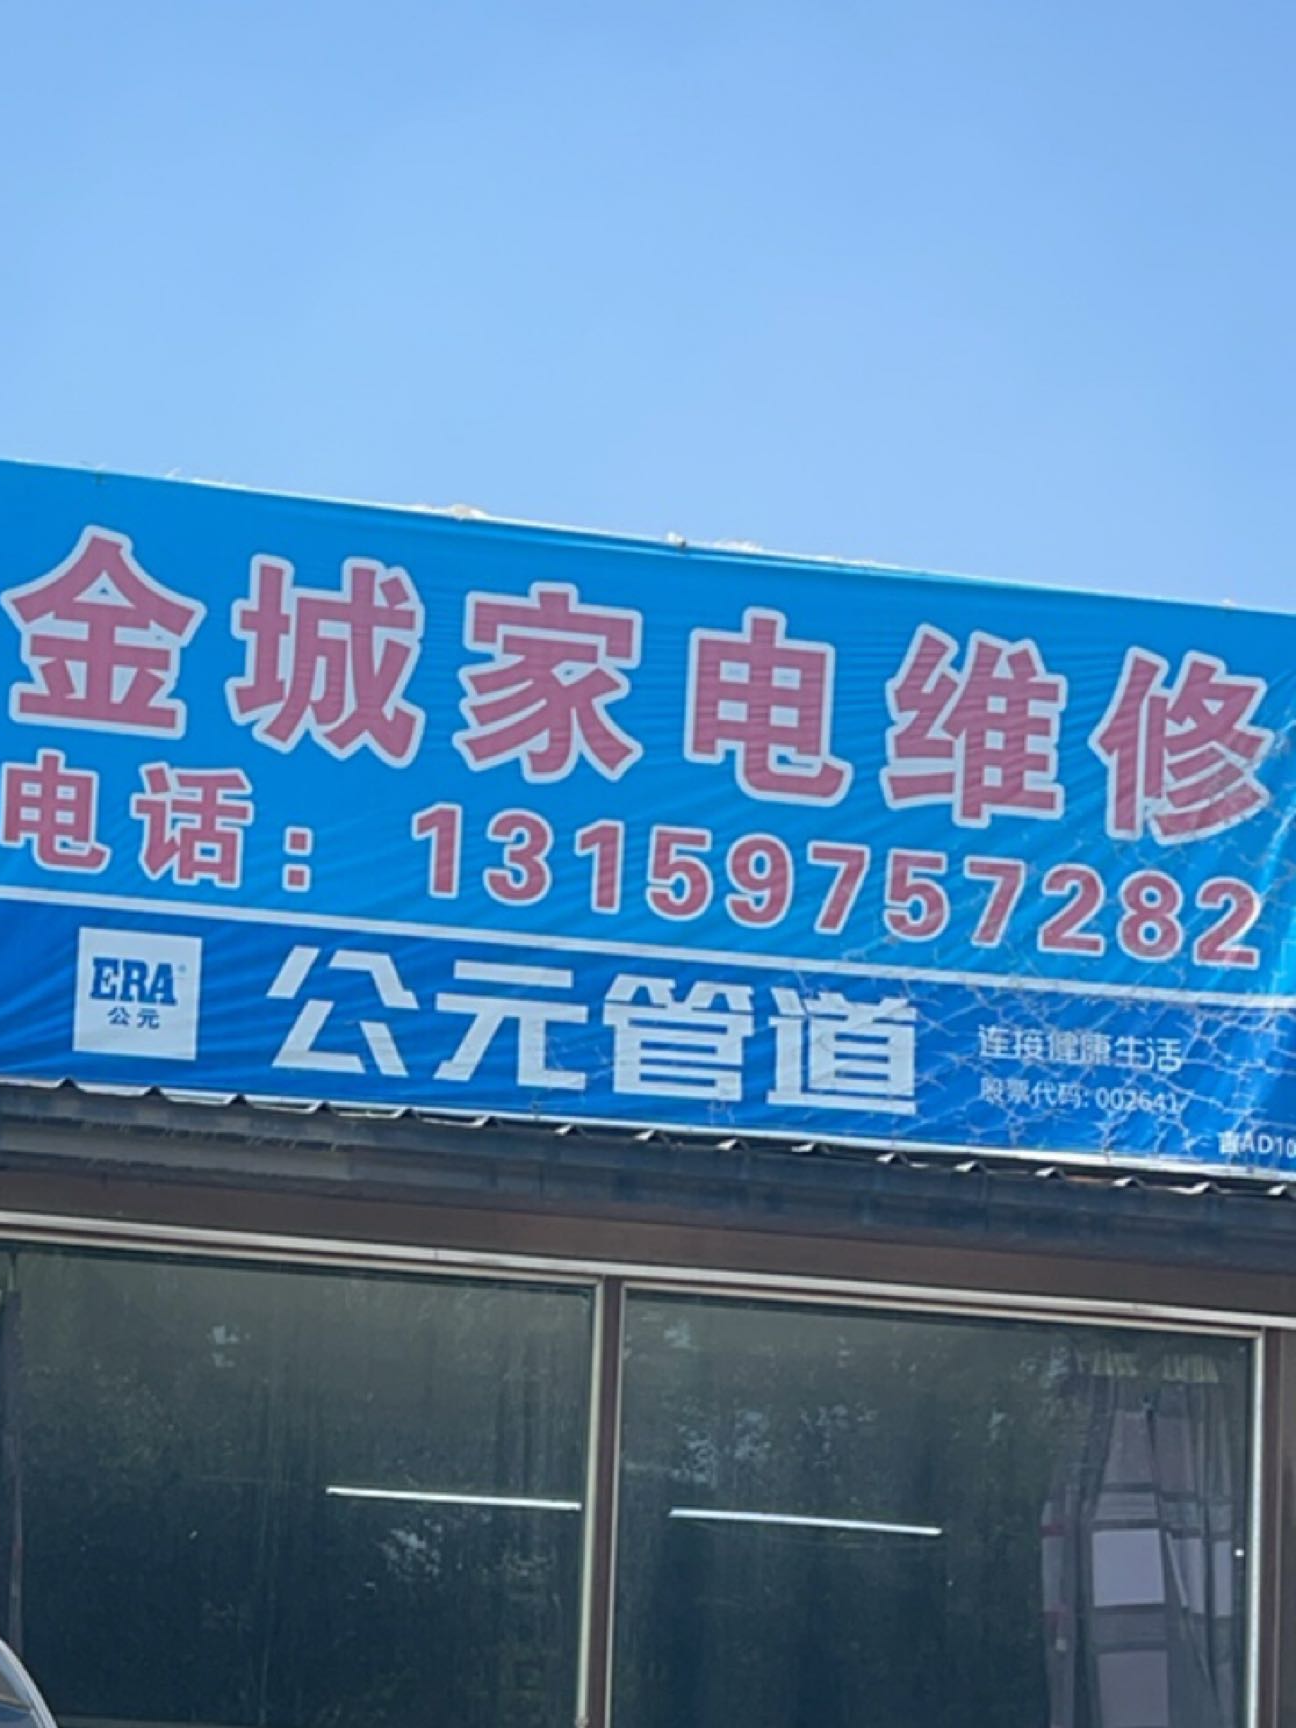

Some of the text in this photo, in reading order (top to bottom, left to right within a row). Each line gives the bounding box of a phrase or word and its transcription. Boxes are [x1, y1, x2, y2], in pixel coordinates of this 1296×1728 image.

[0, 524, 1274, 845] 金城家电维修
[412, 802, 1261, 970] 13159757282
[89, 956, 178, 1006] ERA
[107, 1007, 160, 1029] 公元
[266, 944, 917, 1115] 公元管道
